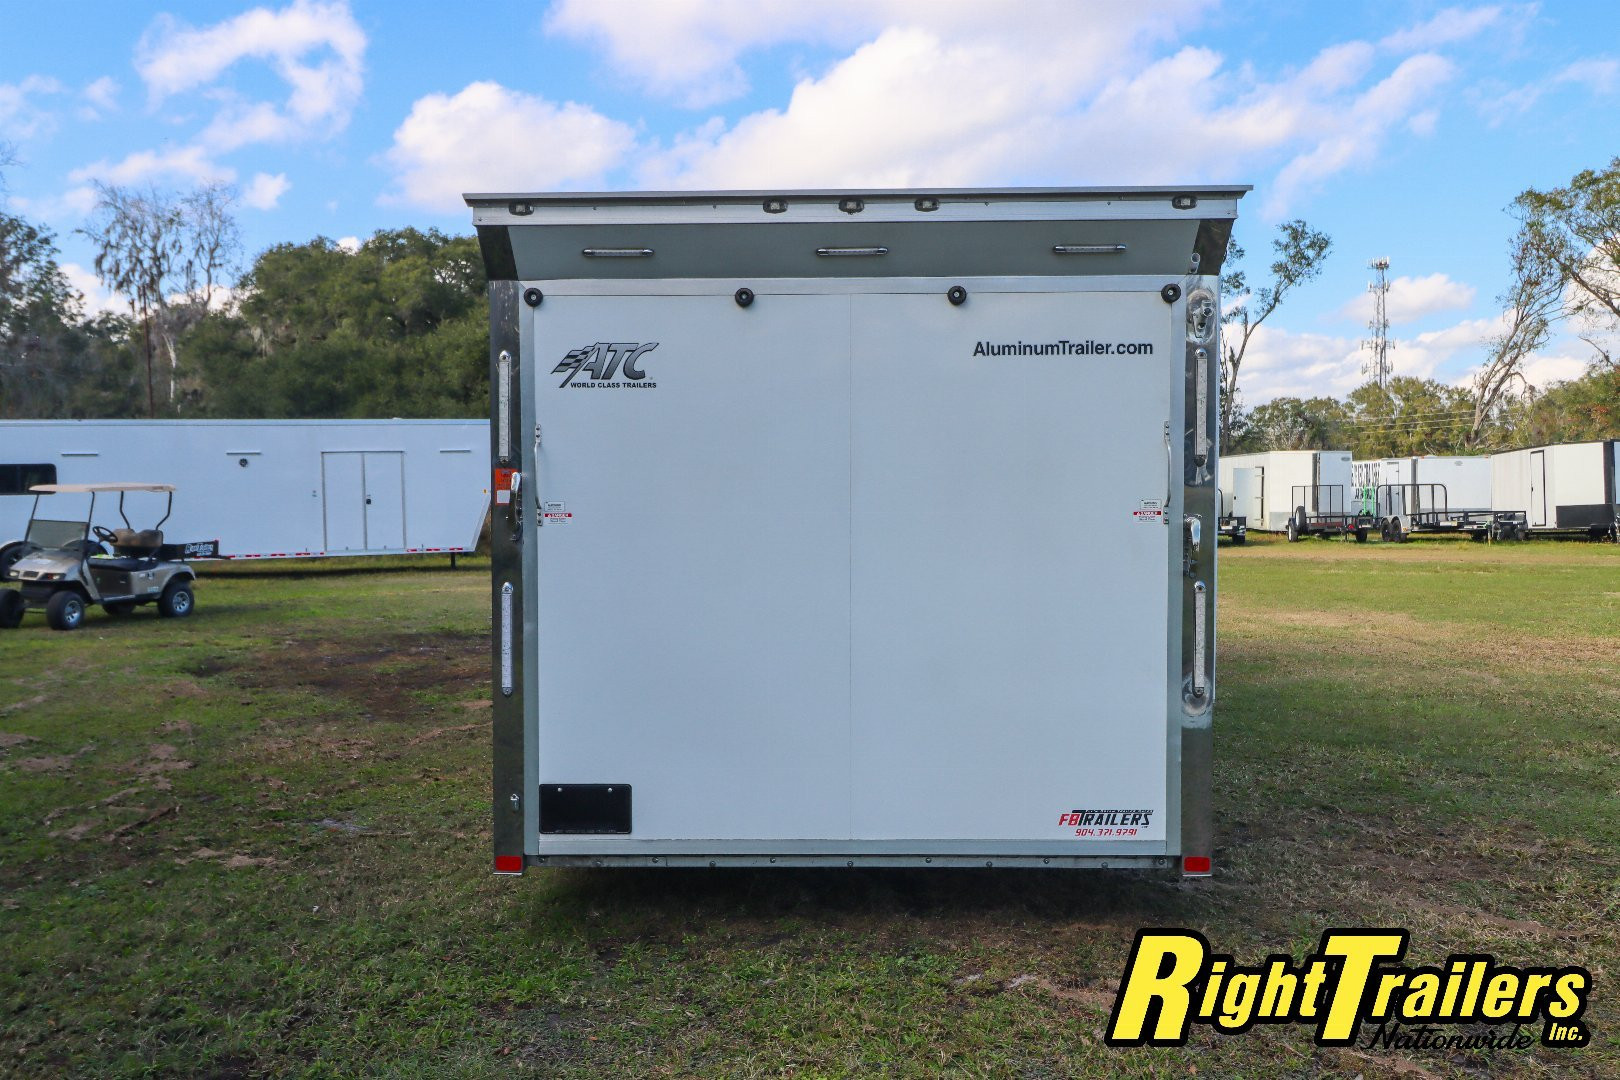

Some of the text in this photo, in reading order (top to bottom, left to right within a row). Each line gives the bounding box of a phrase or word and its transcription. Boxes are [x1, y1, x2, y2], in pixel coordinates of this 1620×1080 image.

[973, 340, 1154, 357] AluminumTrailer.com
[578, 341, 660, 381] ATC
[1075, 828, 1138, 837] 904.371.9791
